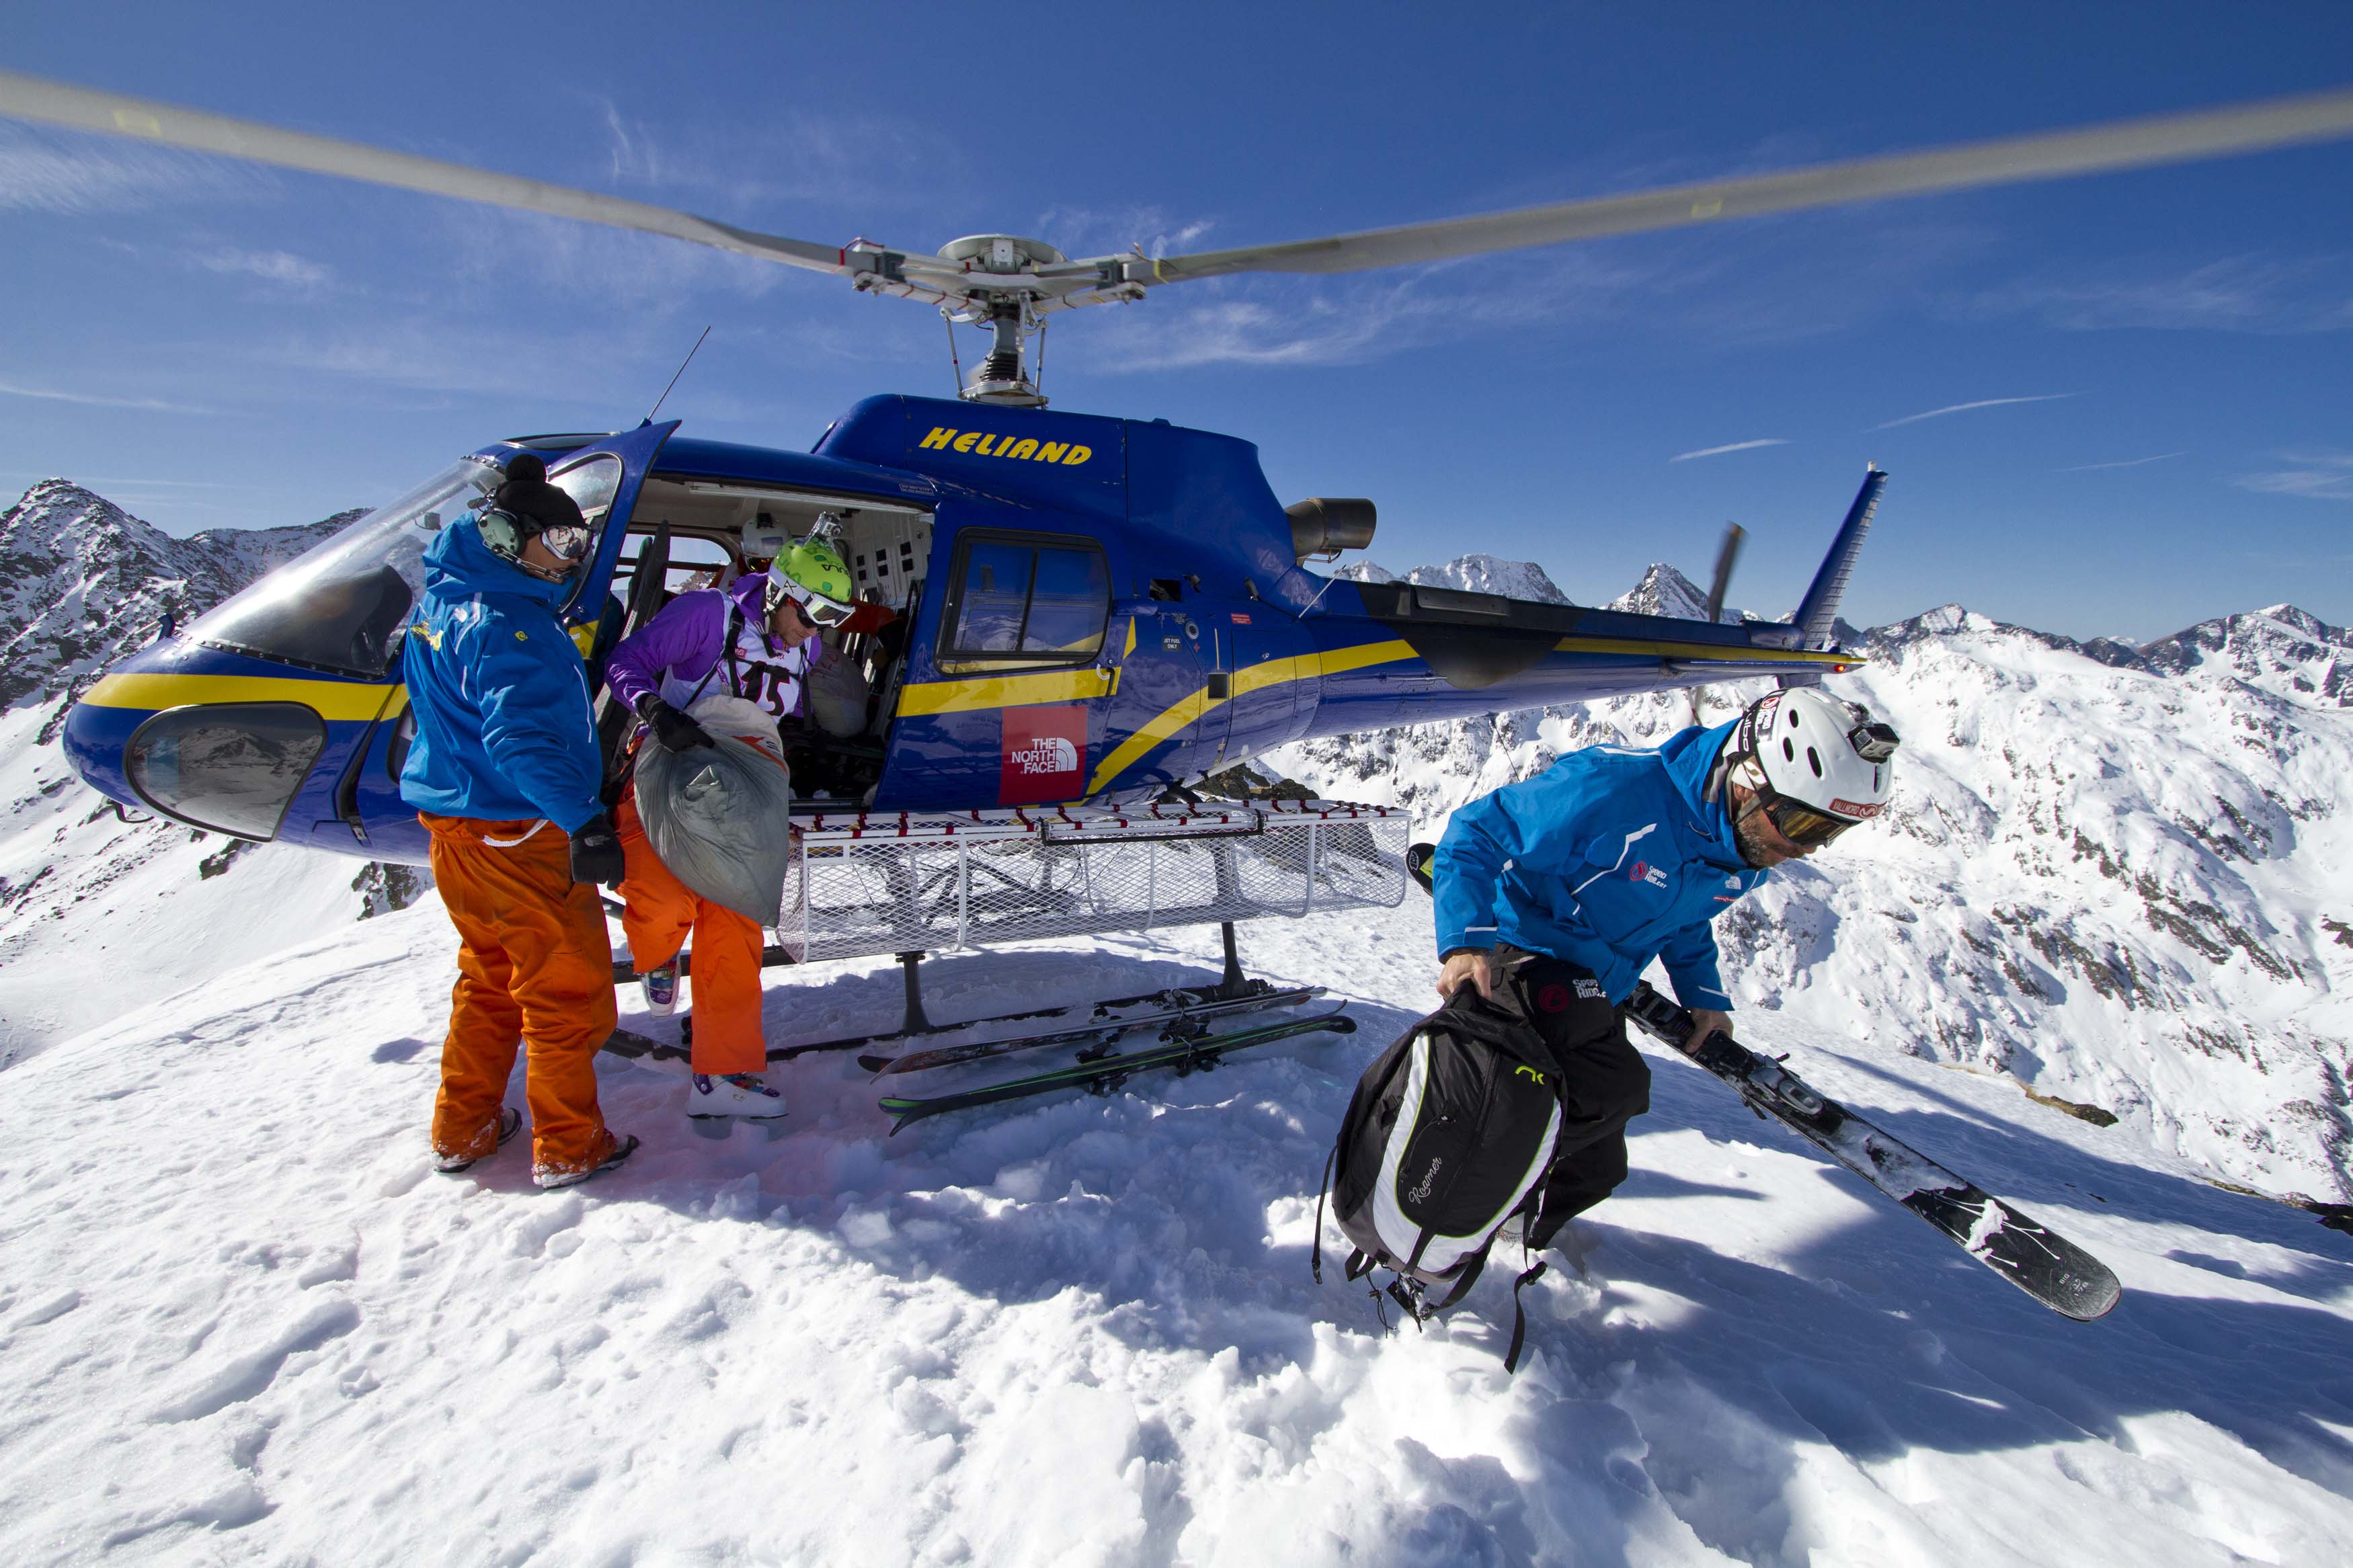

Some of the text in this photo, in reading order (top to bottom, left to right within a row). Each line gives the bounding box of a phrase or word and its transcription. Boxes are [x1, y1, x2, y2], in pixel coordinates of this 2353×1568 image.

[918, 427, 1092, 465] HELIAND
[1031, 737, 1056, 750] THE
[1011, 749, 1055, 764] NORTH
[1024, 761, 1055, 774] FACE
[1408, 1157, 1442, 1205] Roamer
[2059, 1273, 2070, 1284] BIG
